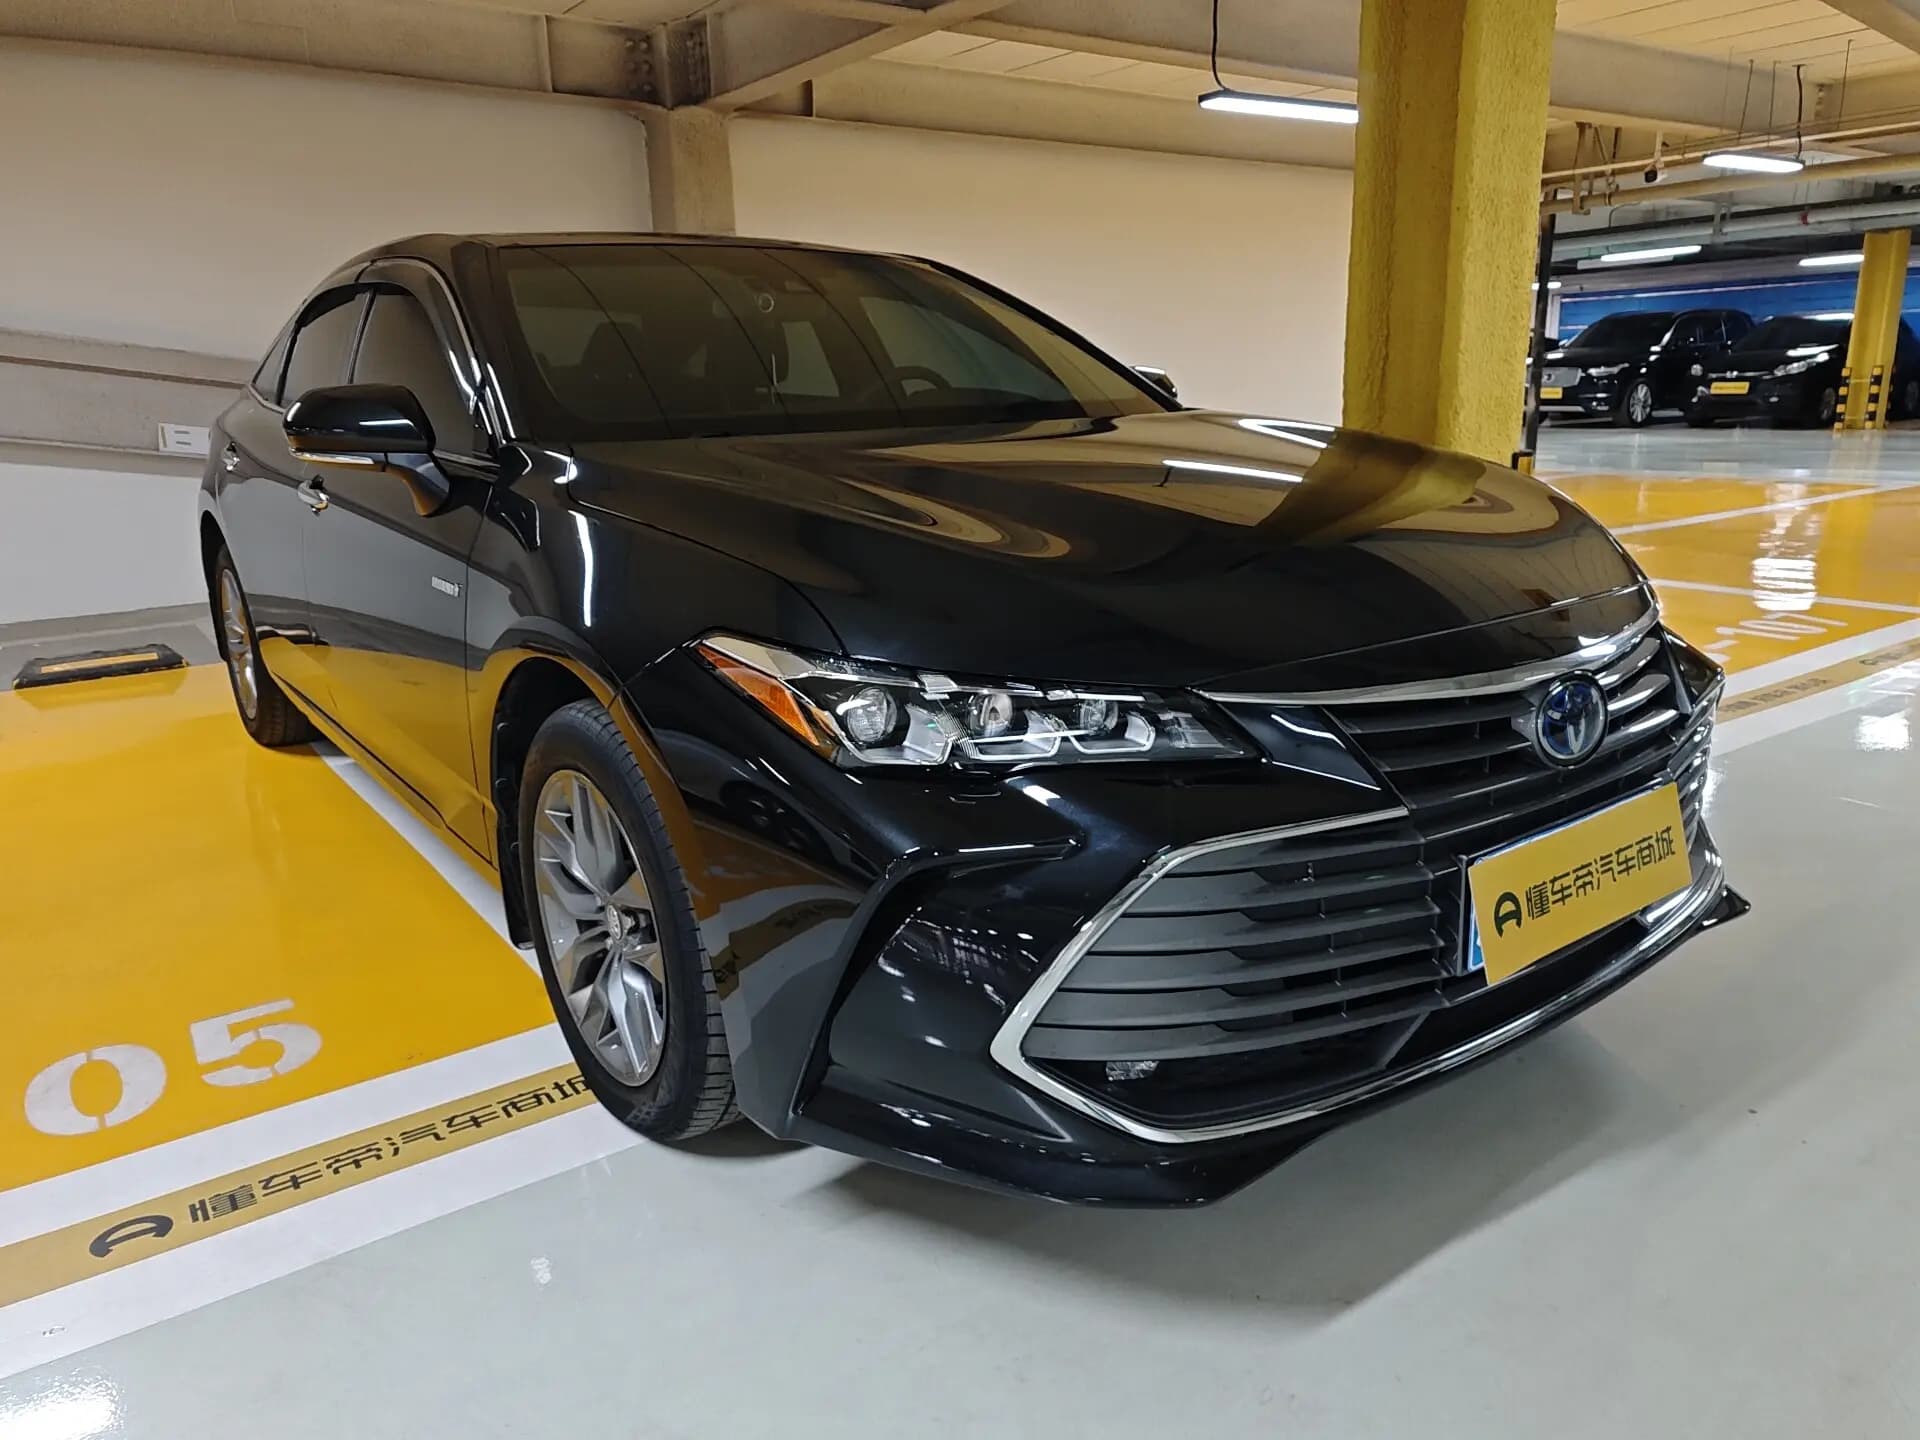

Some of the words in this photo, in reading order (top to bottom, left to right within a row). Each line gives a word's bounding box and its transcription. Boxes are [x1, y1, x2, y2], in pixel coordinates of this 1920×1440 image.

[1525, 825, 1677, 921] 懂车帝汽车商城
[24, 997, 322, 1137] 05
